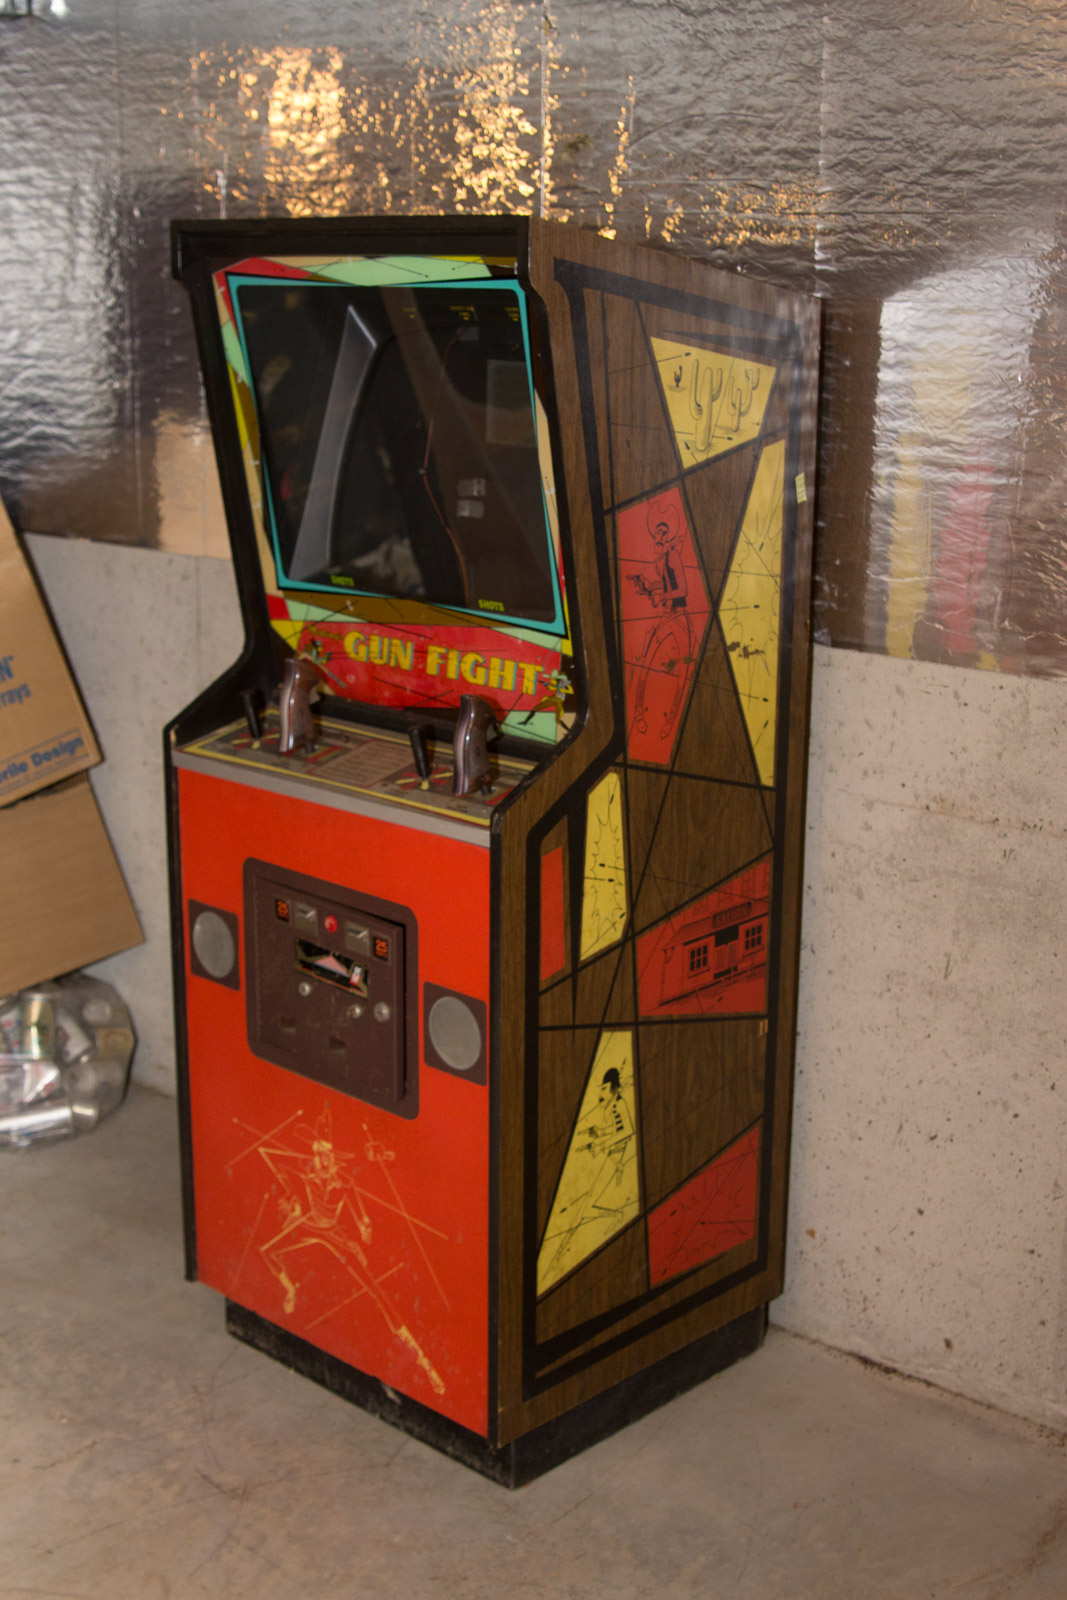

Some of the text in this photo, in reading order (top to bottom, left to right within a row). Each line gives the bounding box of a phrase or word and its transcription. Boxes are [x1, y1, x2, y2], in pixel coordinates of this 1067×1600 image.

[478, 599, 504, 611] SHOTS
[343, 630, 544, 696] GUN FIGHT
[0, 683, 31, 709] rays
[30, 737, 84, 767] Design
